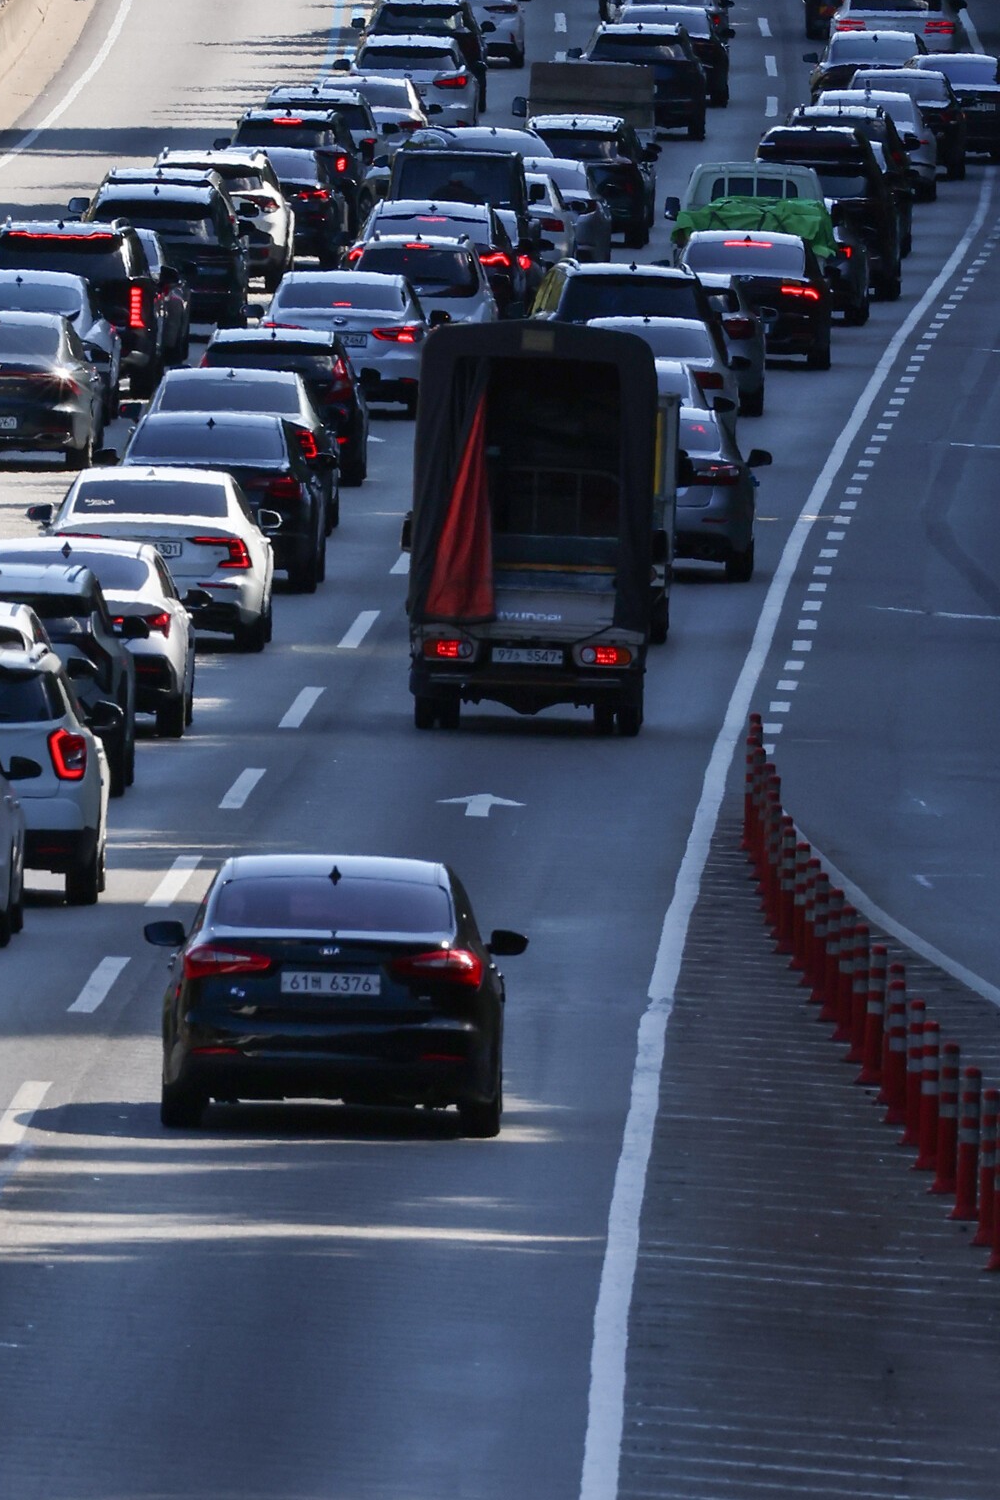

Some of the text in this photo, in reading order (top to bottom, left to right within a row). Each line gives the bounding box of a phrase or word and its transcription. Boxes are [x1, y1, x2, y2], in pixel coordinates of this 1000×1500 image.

[527, 650, 558, 662] 5547
[322, 947, 341, 956] KIA
[329, 974, 372, 992] 6376
